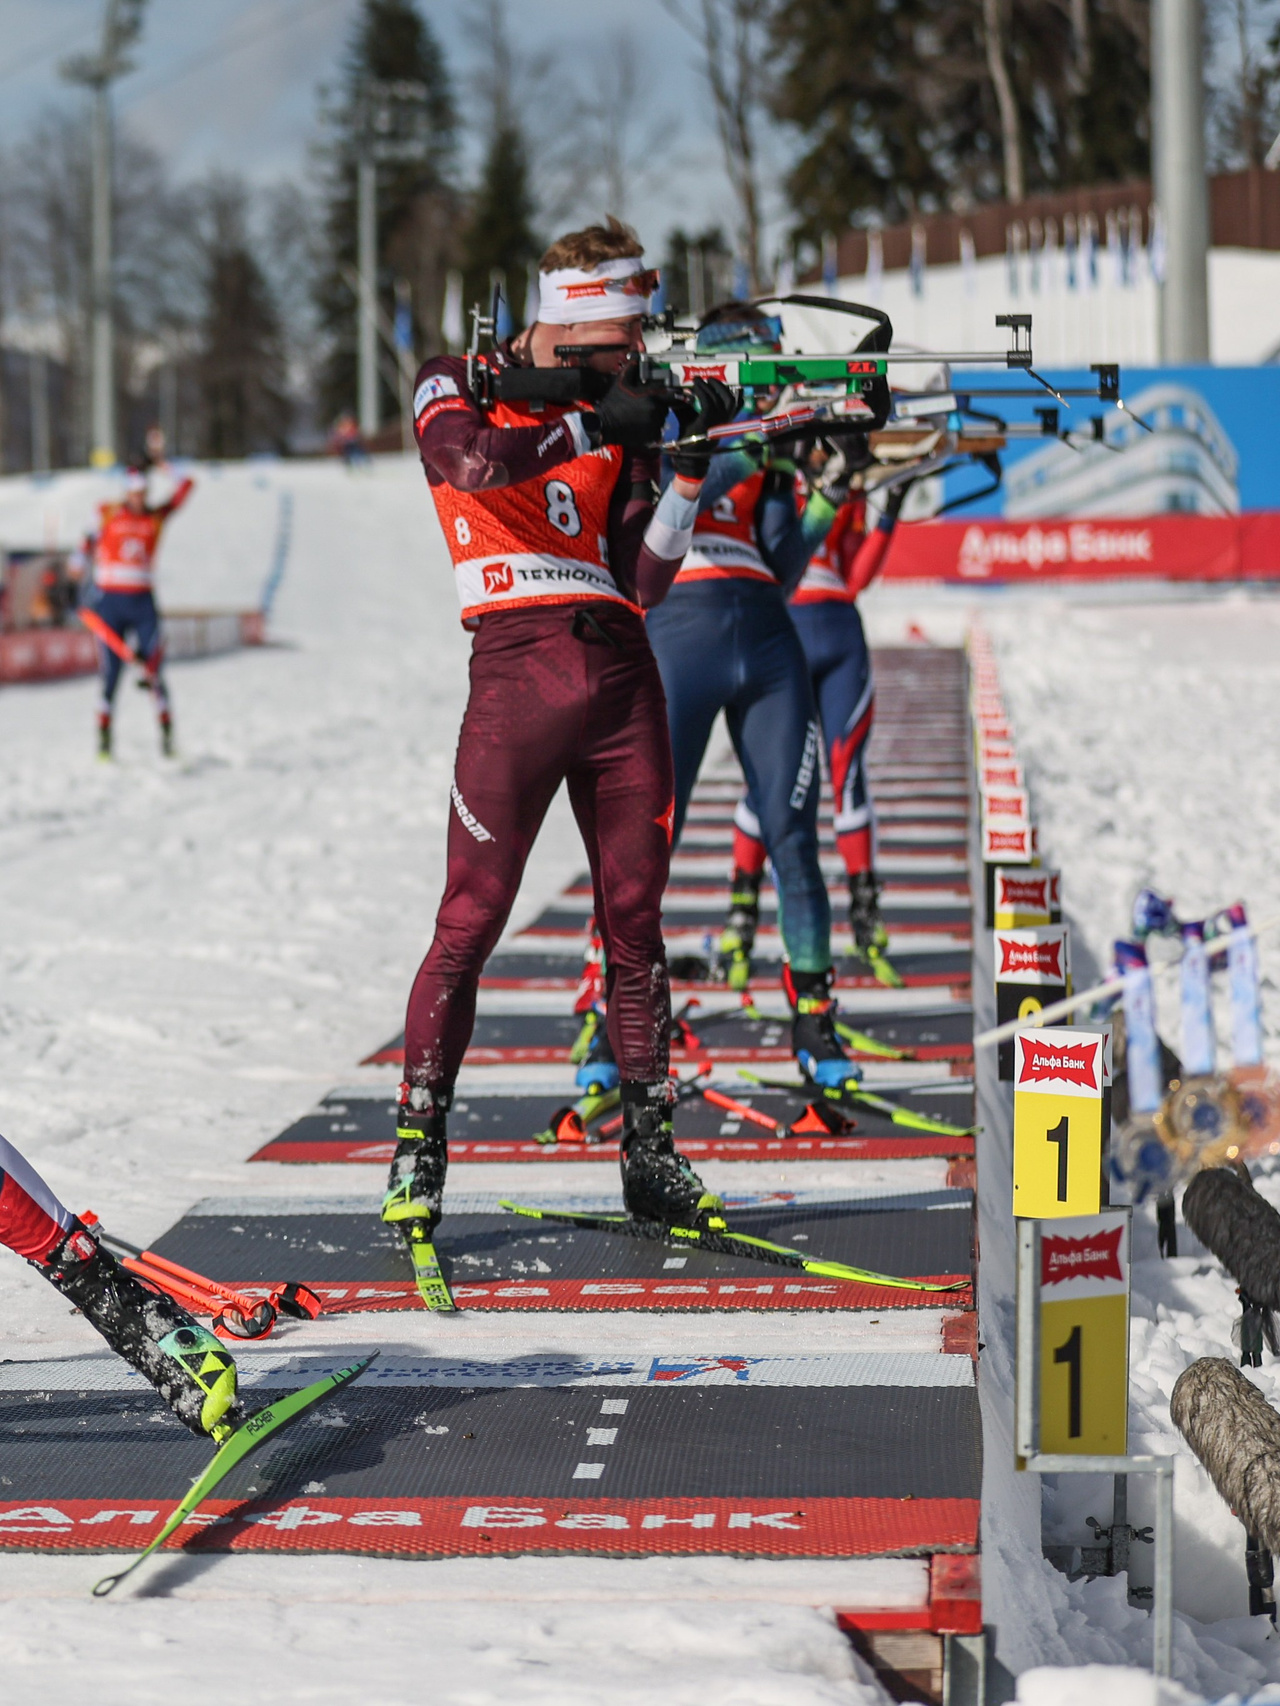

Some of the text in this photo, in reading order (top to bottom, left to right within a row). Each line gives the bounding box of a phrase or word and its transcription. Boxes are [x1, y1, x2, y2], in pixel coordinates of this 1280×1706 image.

[848, 361, 877, 373] ZL
[544, 479, 583, 538] 8
[453, 516, 472, 546] 8
[451, 782, 492, 842] oteam
[1031, 1053, 1086, 1071] Альфа Банк
[1045, 1116, 1070, 1203] 1
[1048, 1247, 1110, 1272] Альфа Банк
[580, 1282, 842, 1295] Банк
[1053, 1325, 1083, 1439] 1
[246, 1409, 276, 1436] FISCHER
[460, 1506, 806, 1530] Банк
